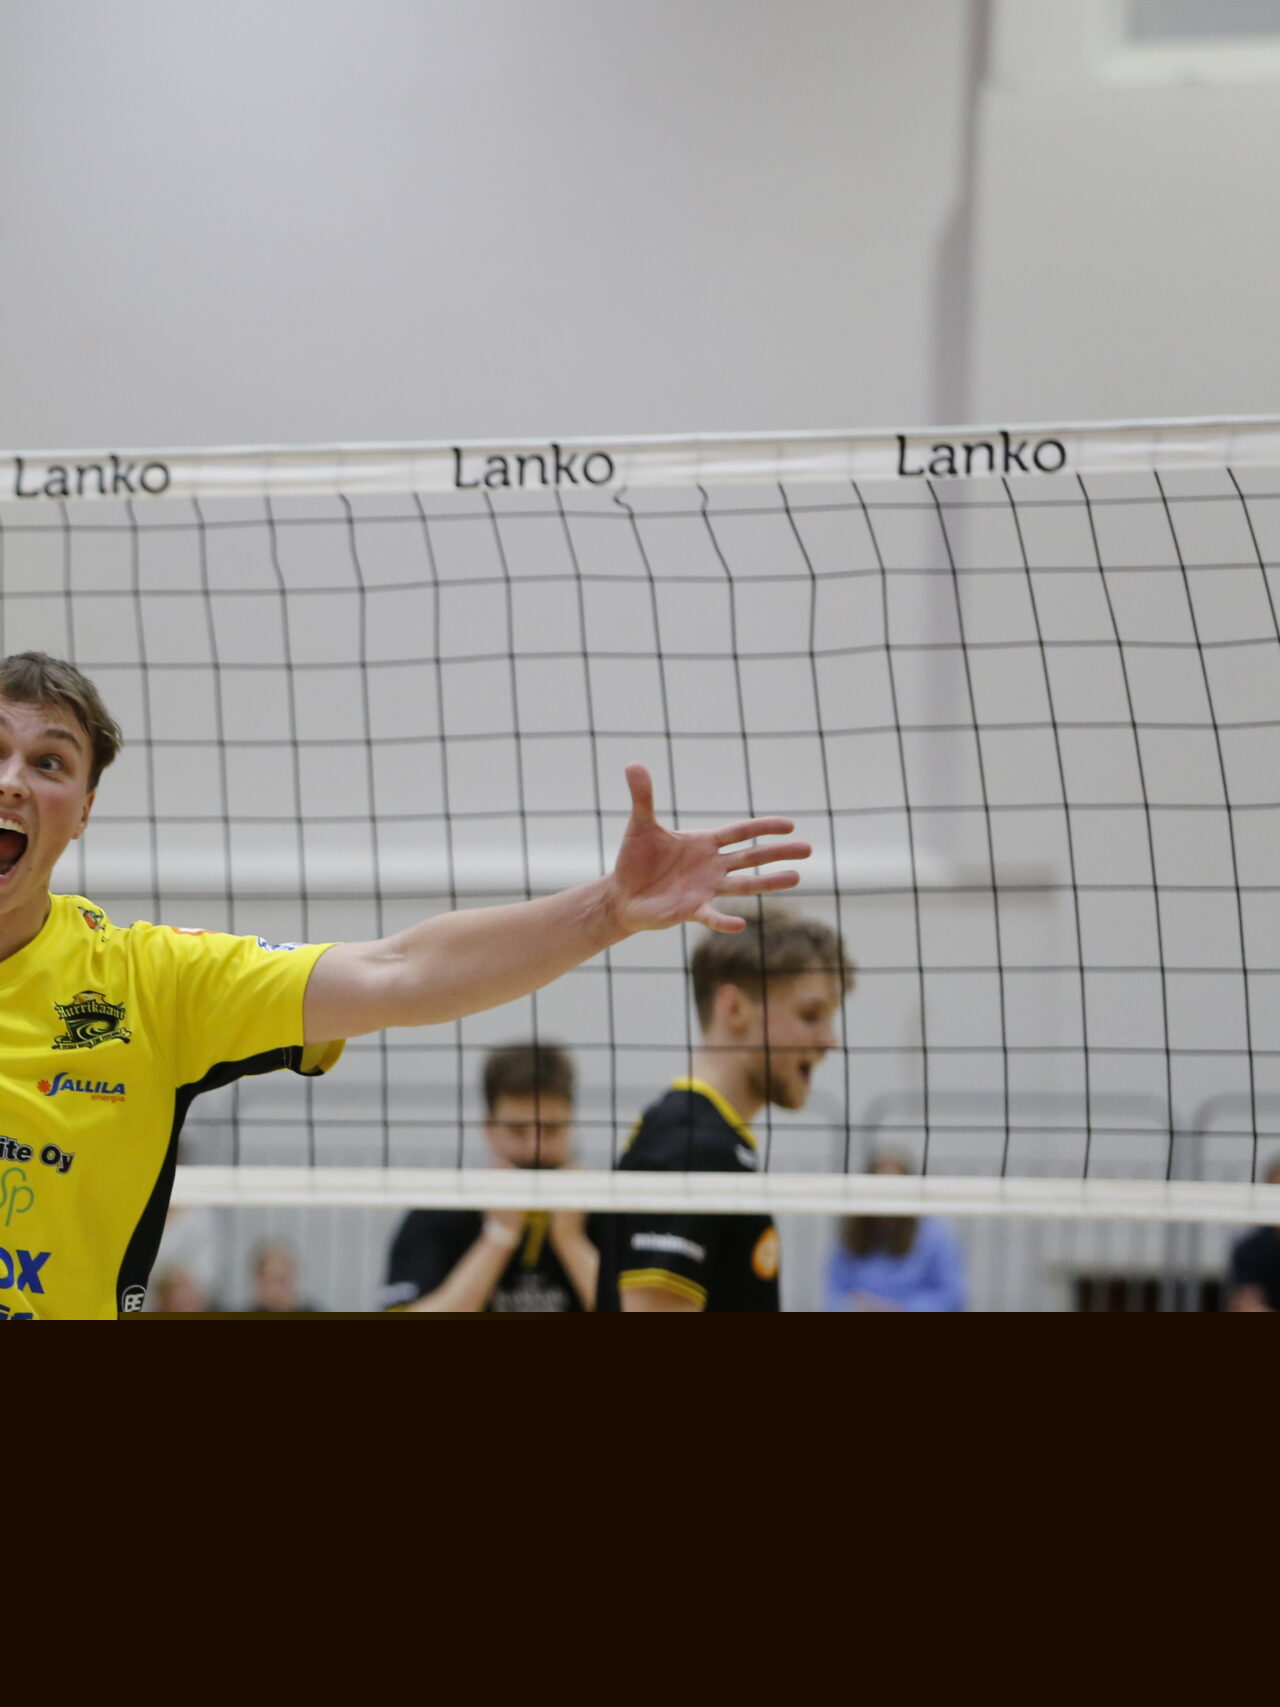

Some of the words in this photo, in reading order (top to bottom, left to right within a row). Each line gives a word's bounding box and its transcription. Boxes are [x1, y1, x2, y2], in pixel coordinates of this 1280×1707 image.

[450, 444, 615, 489] Lanko
[894, 430, 1067, 476] Lanko
[14, 454, 171, 499] Lanko
[44, 1072, 125, 1096] SALLILA
[39, 1143, 75, 1174] Oy
